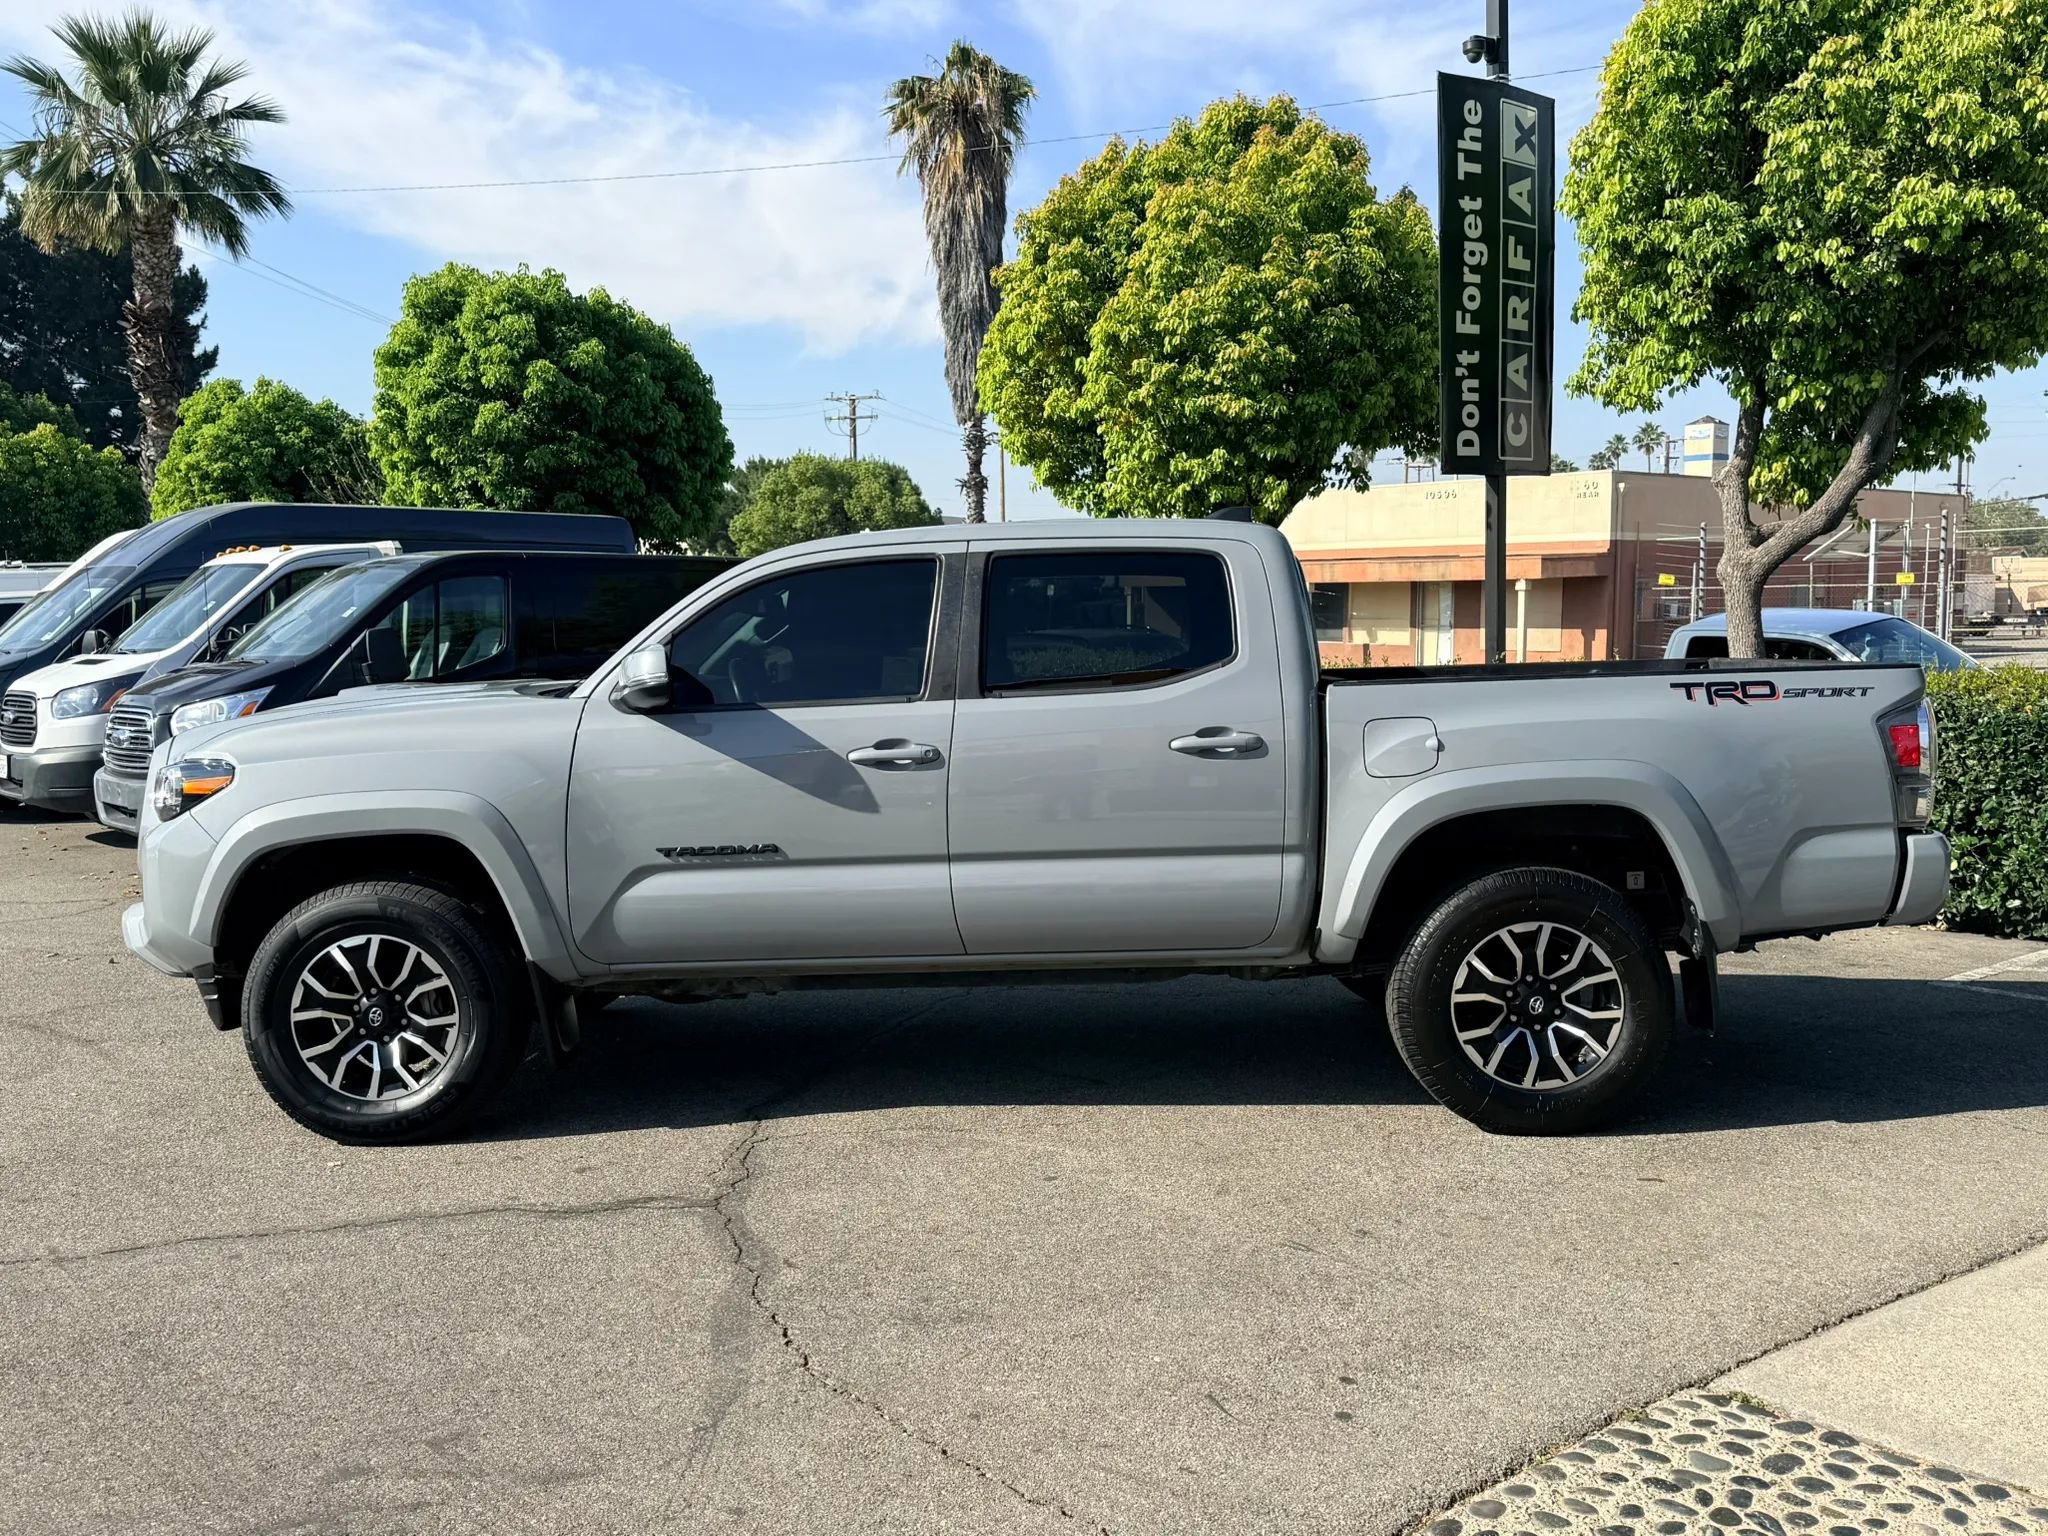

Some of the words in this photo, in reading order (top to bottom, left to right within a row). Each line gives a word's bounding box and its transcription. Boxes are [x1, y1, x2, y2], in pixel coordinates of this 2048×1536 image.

[1457, 99, 1483, 181] The
[1456, 195, 1488, 335] Forget
[1506, 110, 1537, 448] CARFAX
[1456, 349, 1480, 457] Don't
[1670, 680, 1781, 707] TRD
[1782, 686, 1875, 699] SPORT
[656, 843, 780, 858] TACOMA
